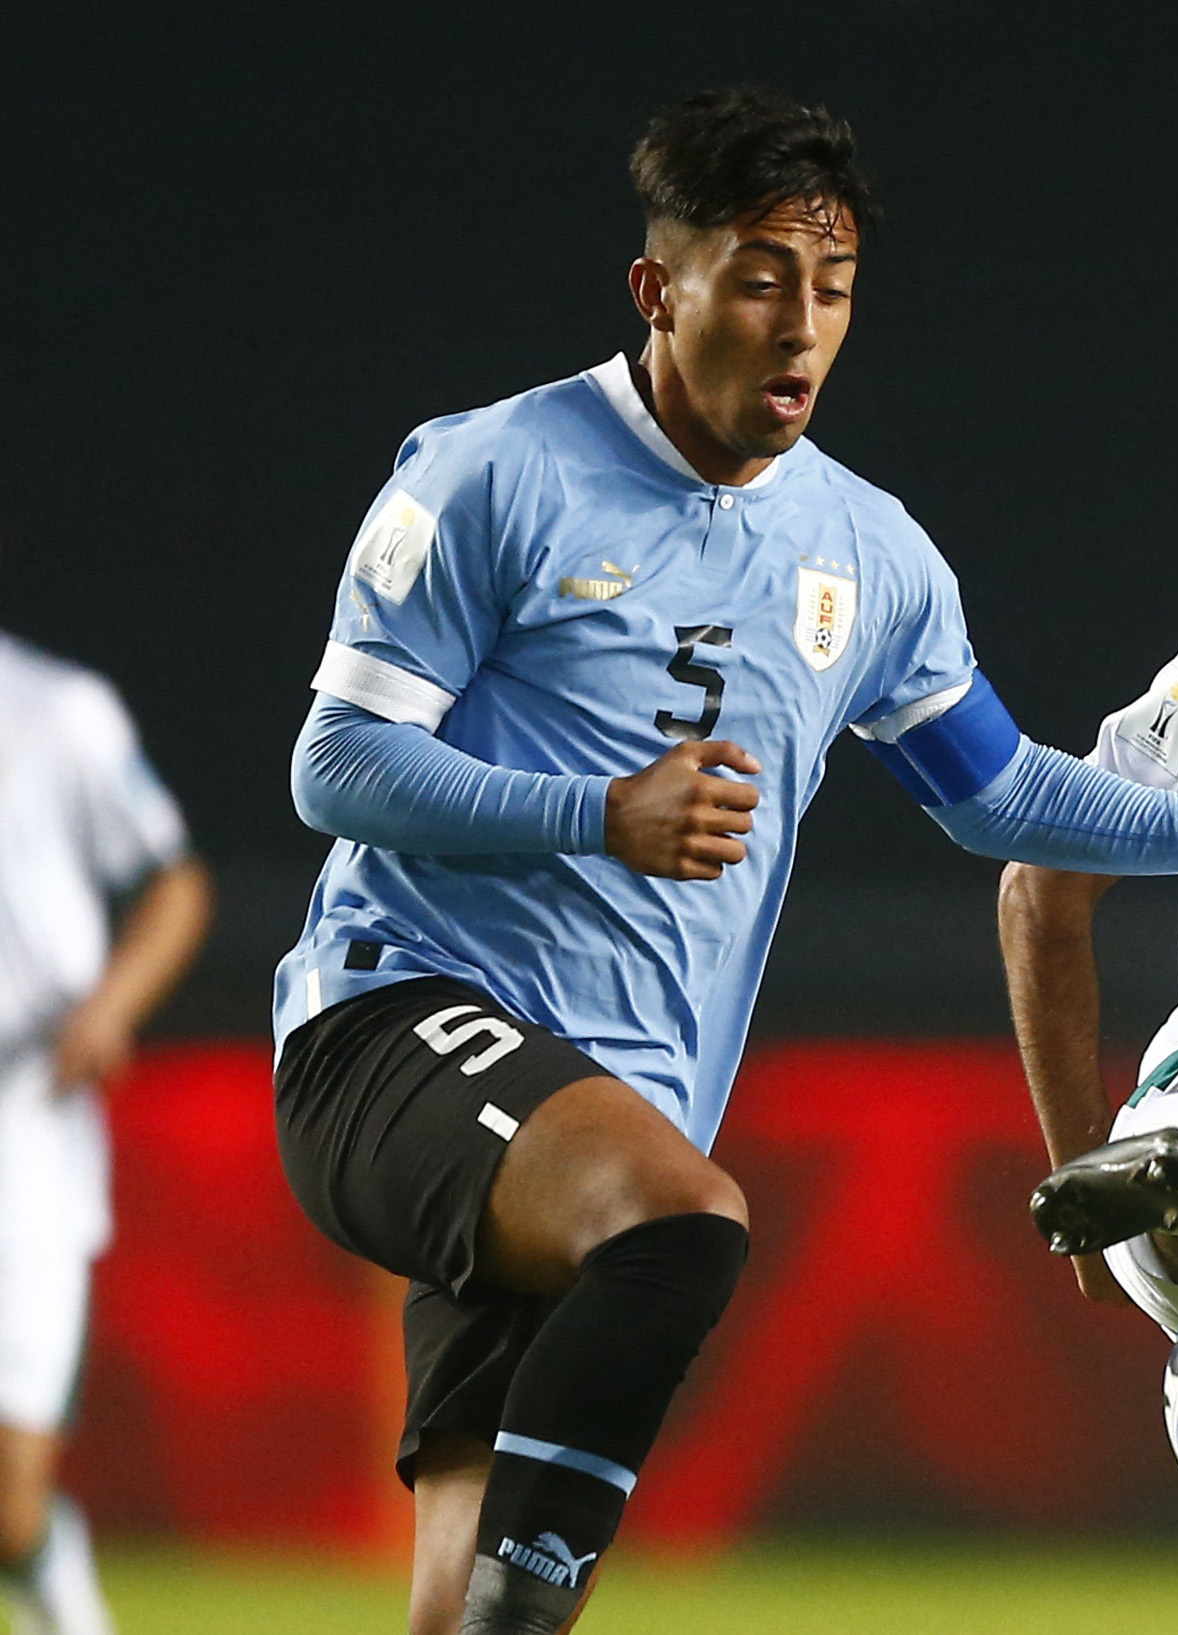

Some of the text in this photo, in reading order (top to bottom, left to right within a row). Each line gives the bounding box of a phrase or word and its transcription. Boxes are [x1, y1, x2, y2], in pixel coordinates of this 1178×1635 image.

[653, 624, 734, 742] 5
[412, 1004, 526, 1077] 5
[497, 1536, 570, 1588] PUMA
